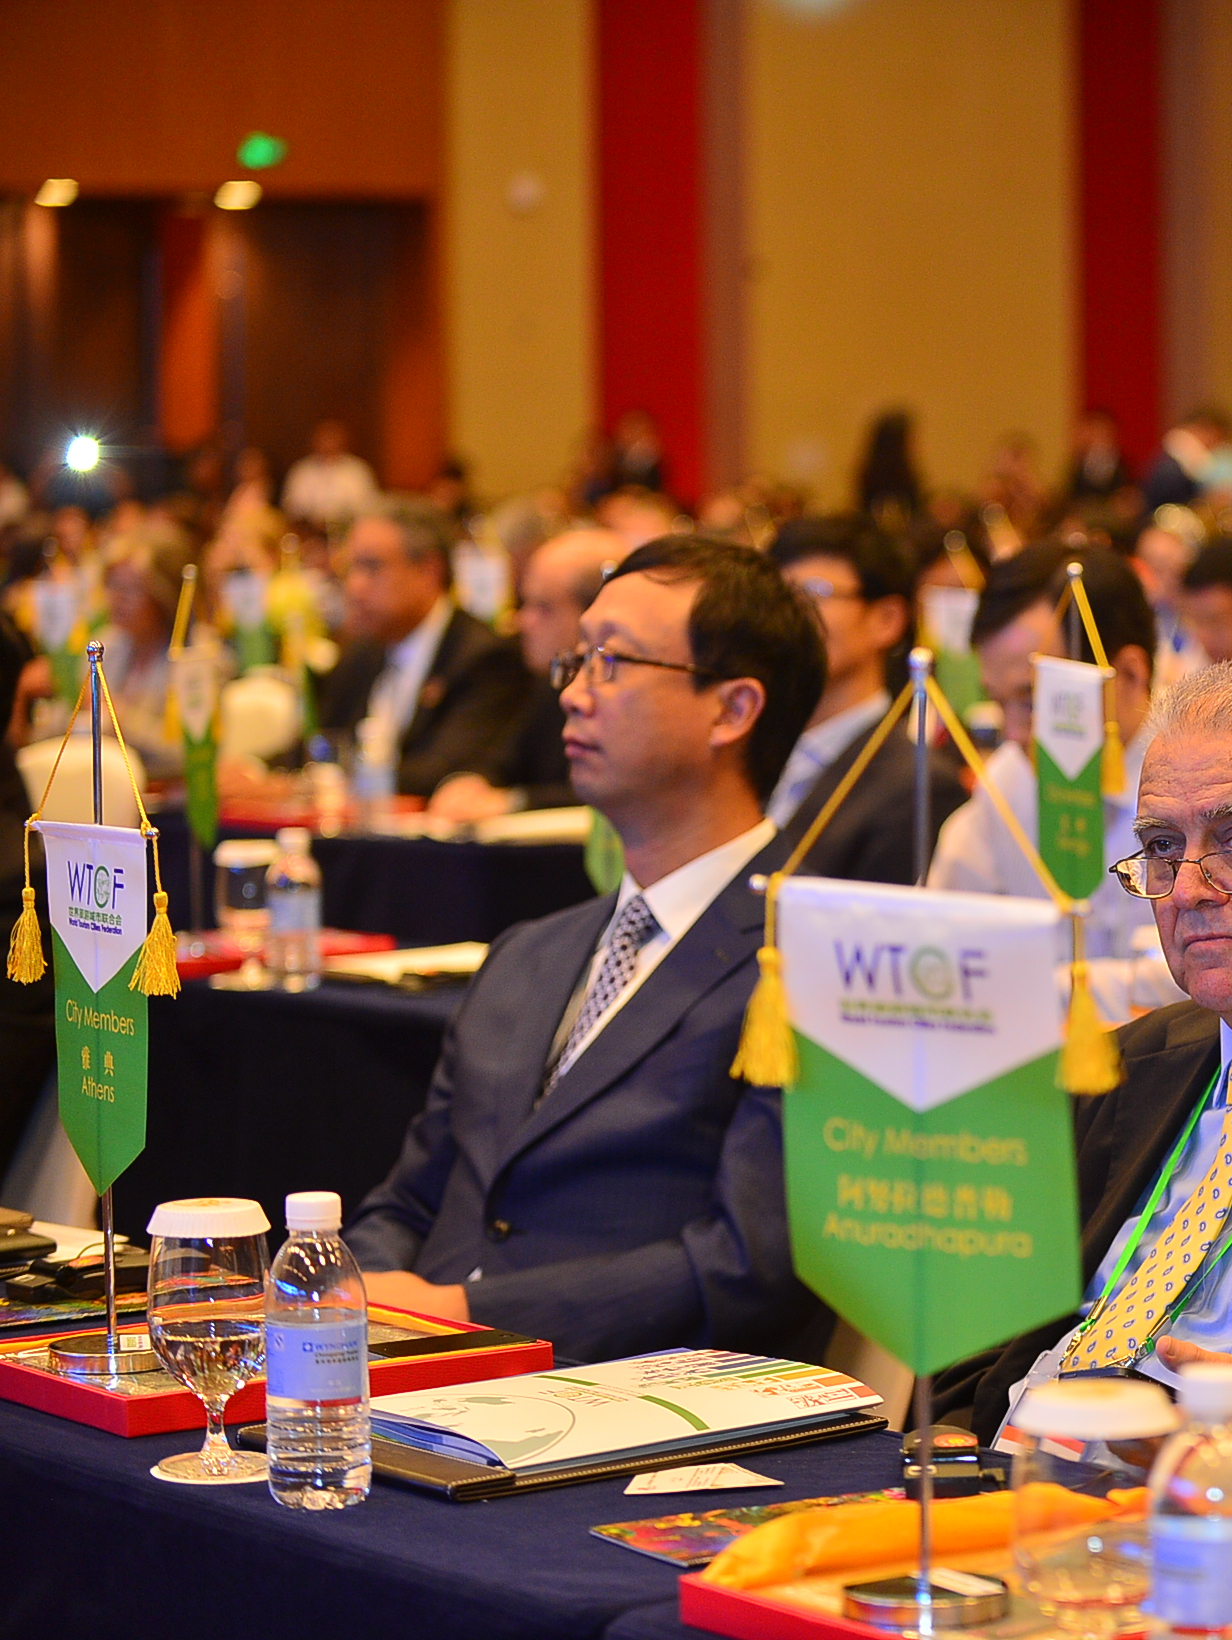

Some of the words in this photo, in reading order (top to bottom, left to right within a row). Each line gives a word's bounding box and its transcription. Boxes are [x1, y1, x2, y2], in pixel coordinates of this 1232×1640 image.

[67, 860, 125, 910] WTCF
[834, 939, 987, 1003] WTCF
[65, 999, 83, 1030] City
[83, 1006, 135, 1036] Members
[81, 1075, 115, 1103] Athens
[823, 1116, 880, 1161] City
[883, 1126, 1029, 1167] Members
